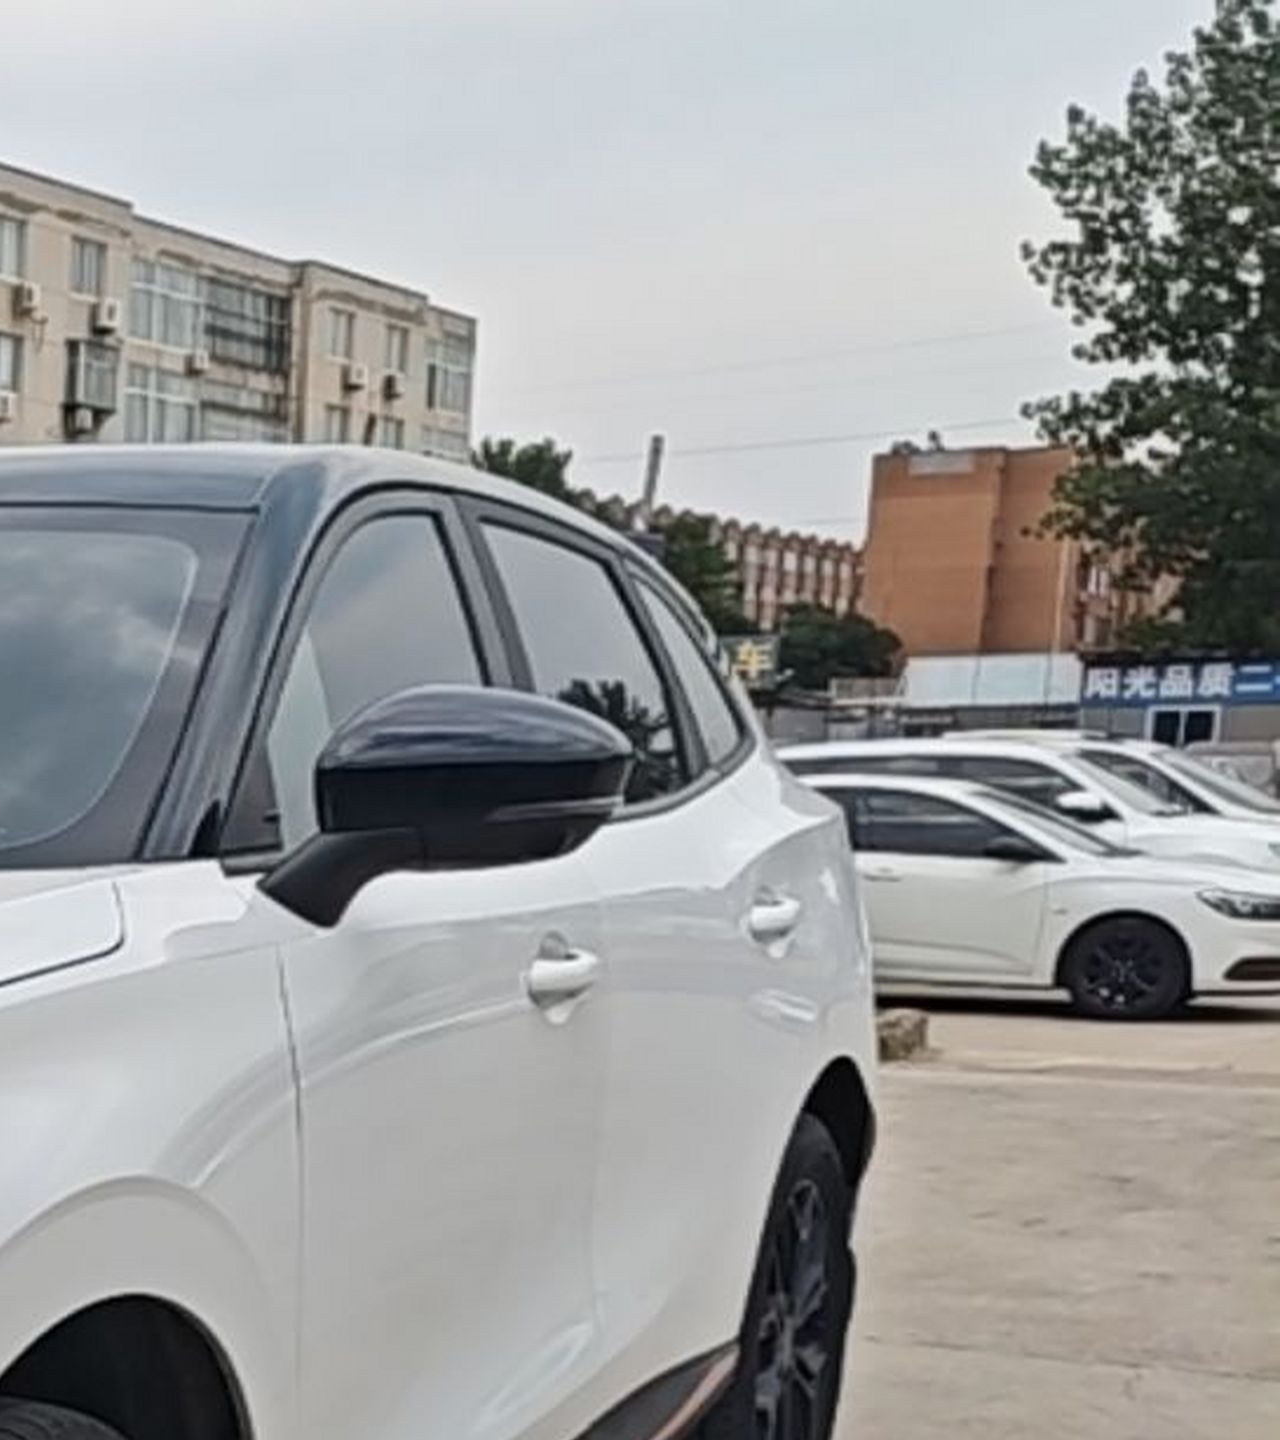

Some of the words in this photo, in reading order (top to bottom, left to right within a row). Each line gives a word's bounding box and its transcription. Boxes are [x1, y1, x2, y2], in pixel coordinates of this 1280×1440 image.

[1084, 661, 1280, 699] 阳光品质二
